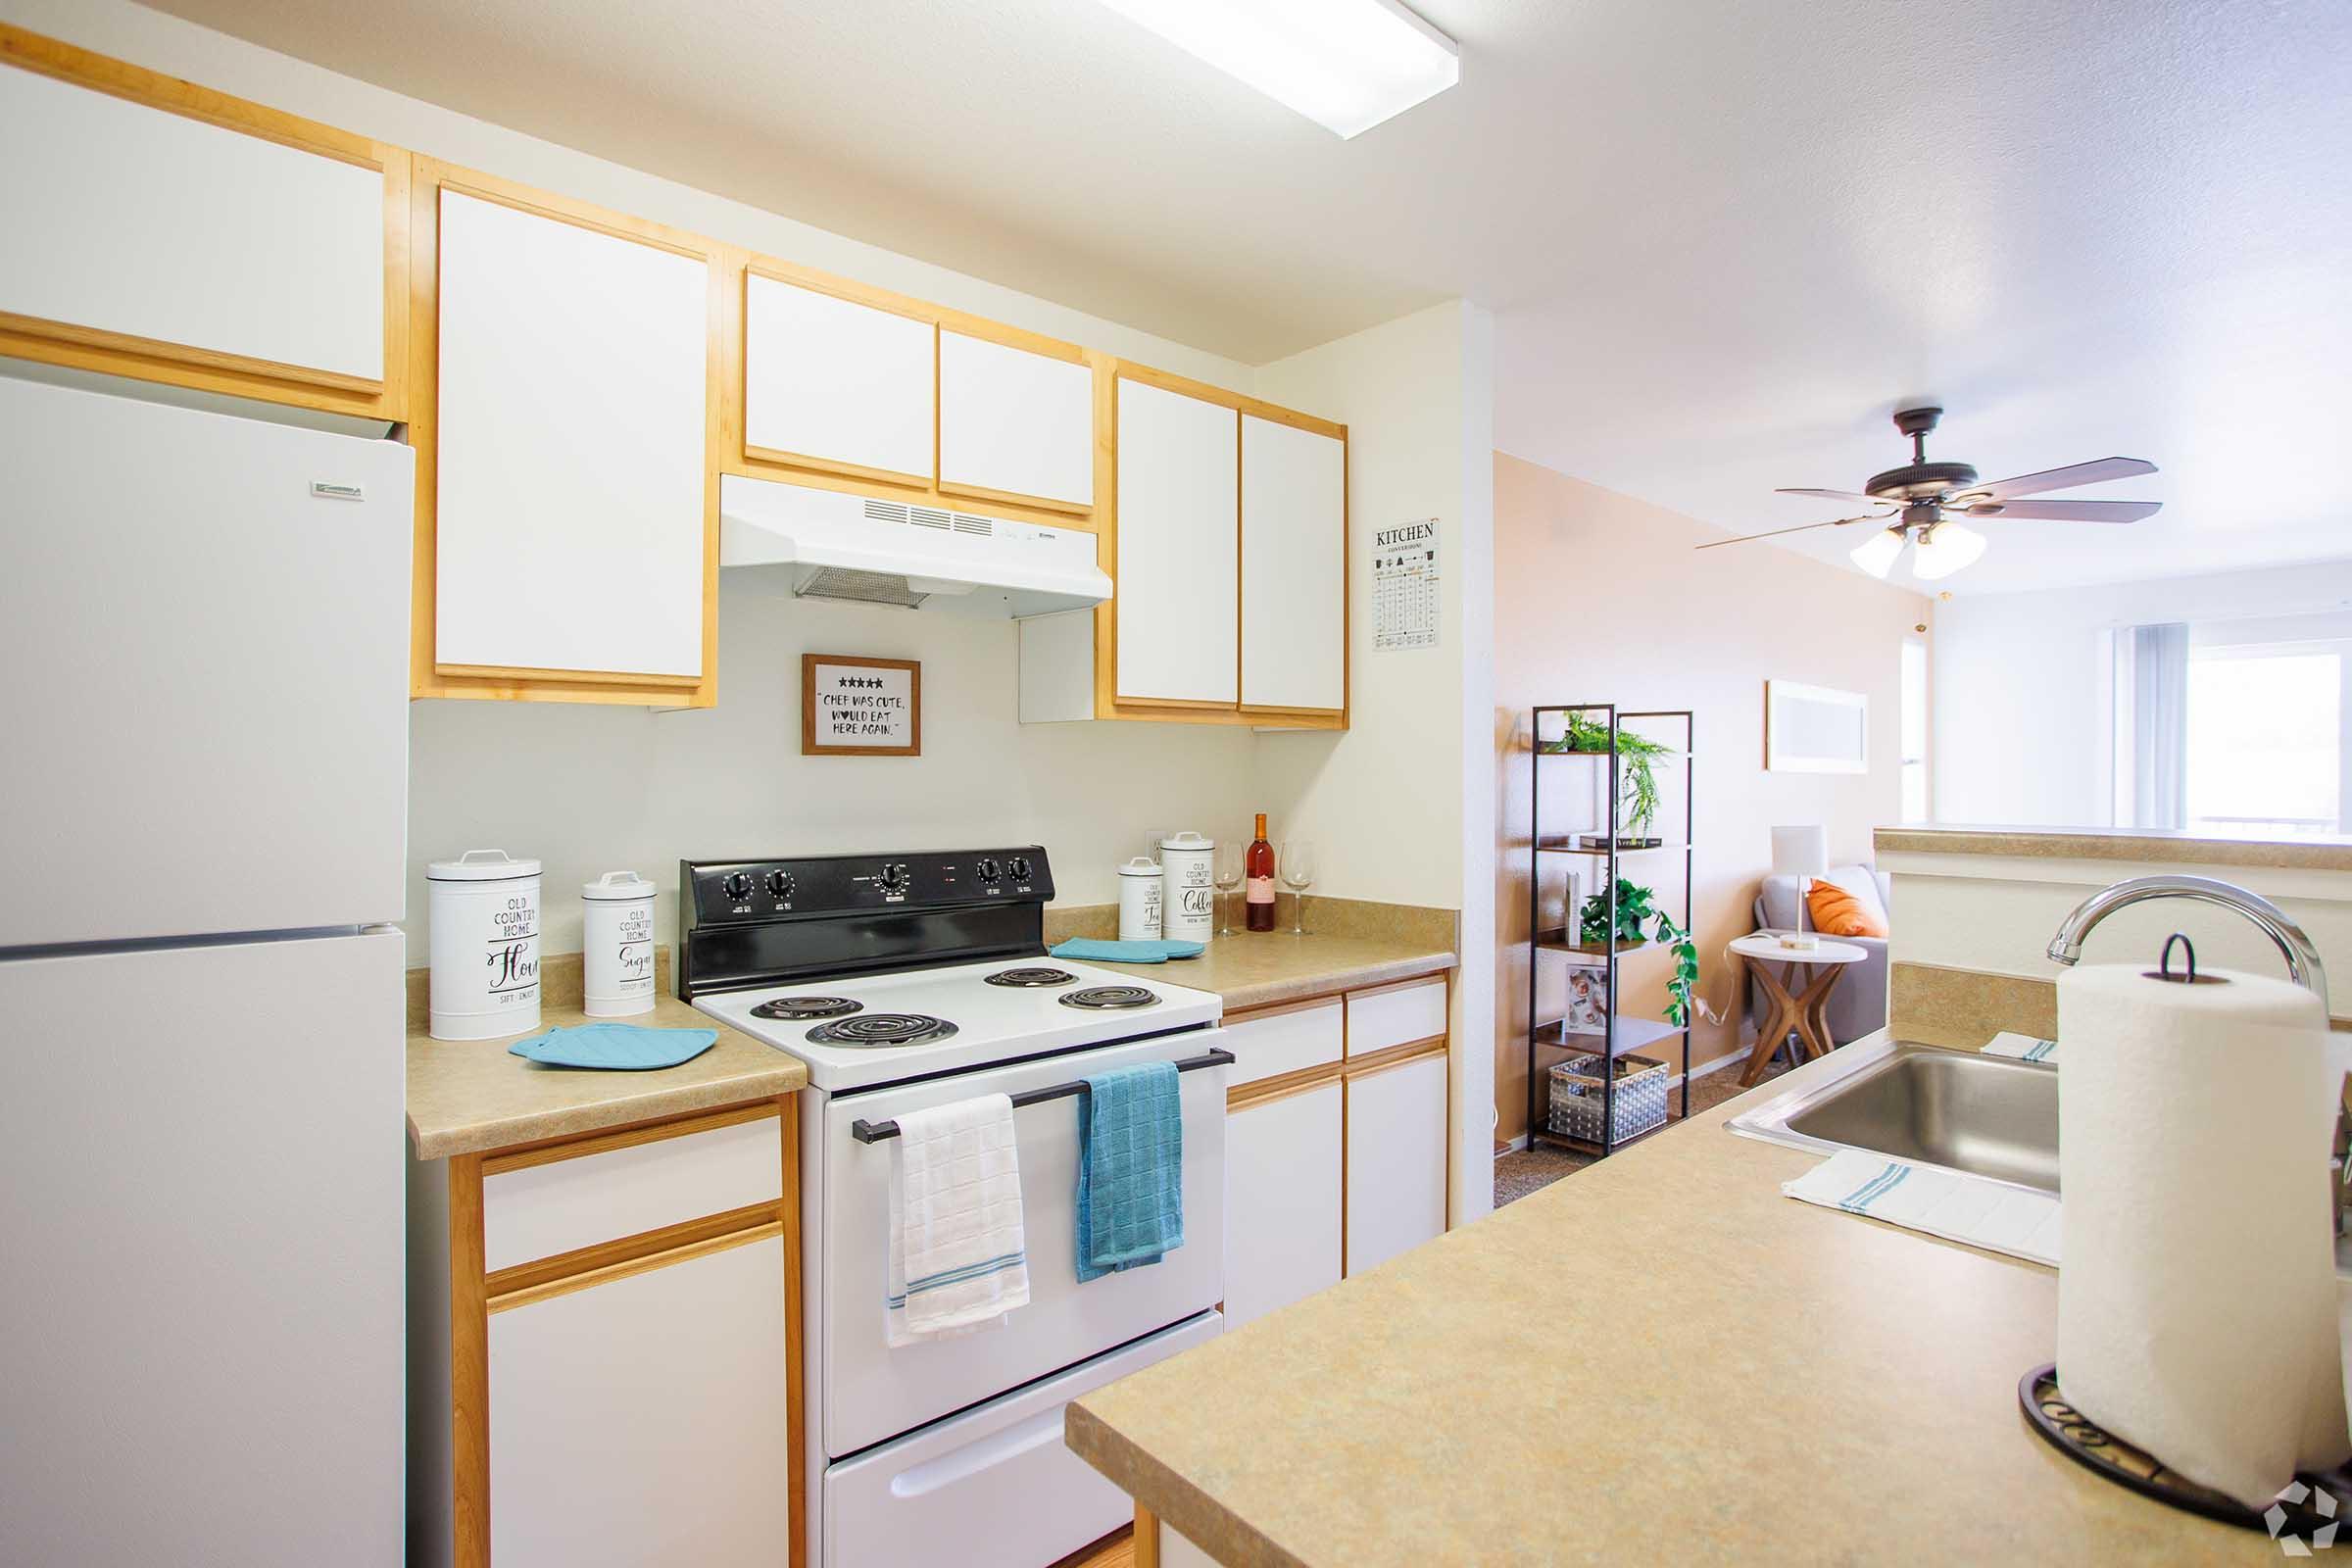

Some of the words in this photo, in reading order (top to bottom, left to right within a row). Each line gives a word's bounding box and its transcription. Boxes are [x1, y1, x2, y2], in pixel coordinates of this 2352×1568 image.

[1377, 522, 1434, 546] KITCHEN
[853, 696, 873, 708] WAS
[876, 697, 906, 710] CUTE,
[870, 711, 891, 722] EAT
[833, 723, 858, 734] HERE
[508, 898, 526, 909] OLD
[494, 909, 535, 924] COUNTRY
[629, 909, 645, 921] OLD
[504, 922, 530, 937] HOME
[626, 930, 647, 941] HOME
[486, 942, 538, 988] Flour
[619, 946, 651, 977] Sugar
[500, 994, 515, 1004] SIFT
